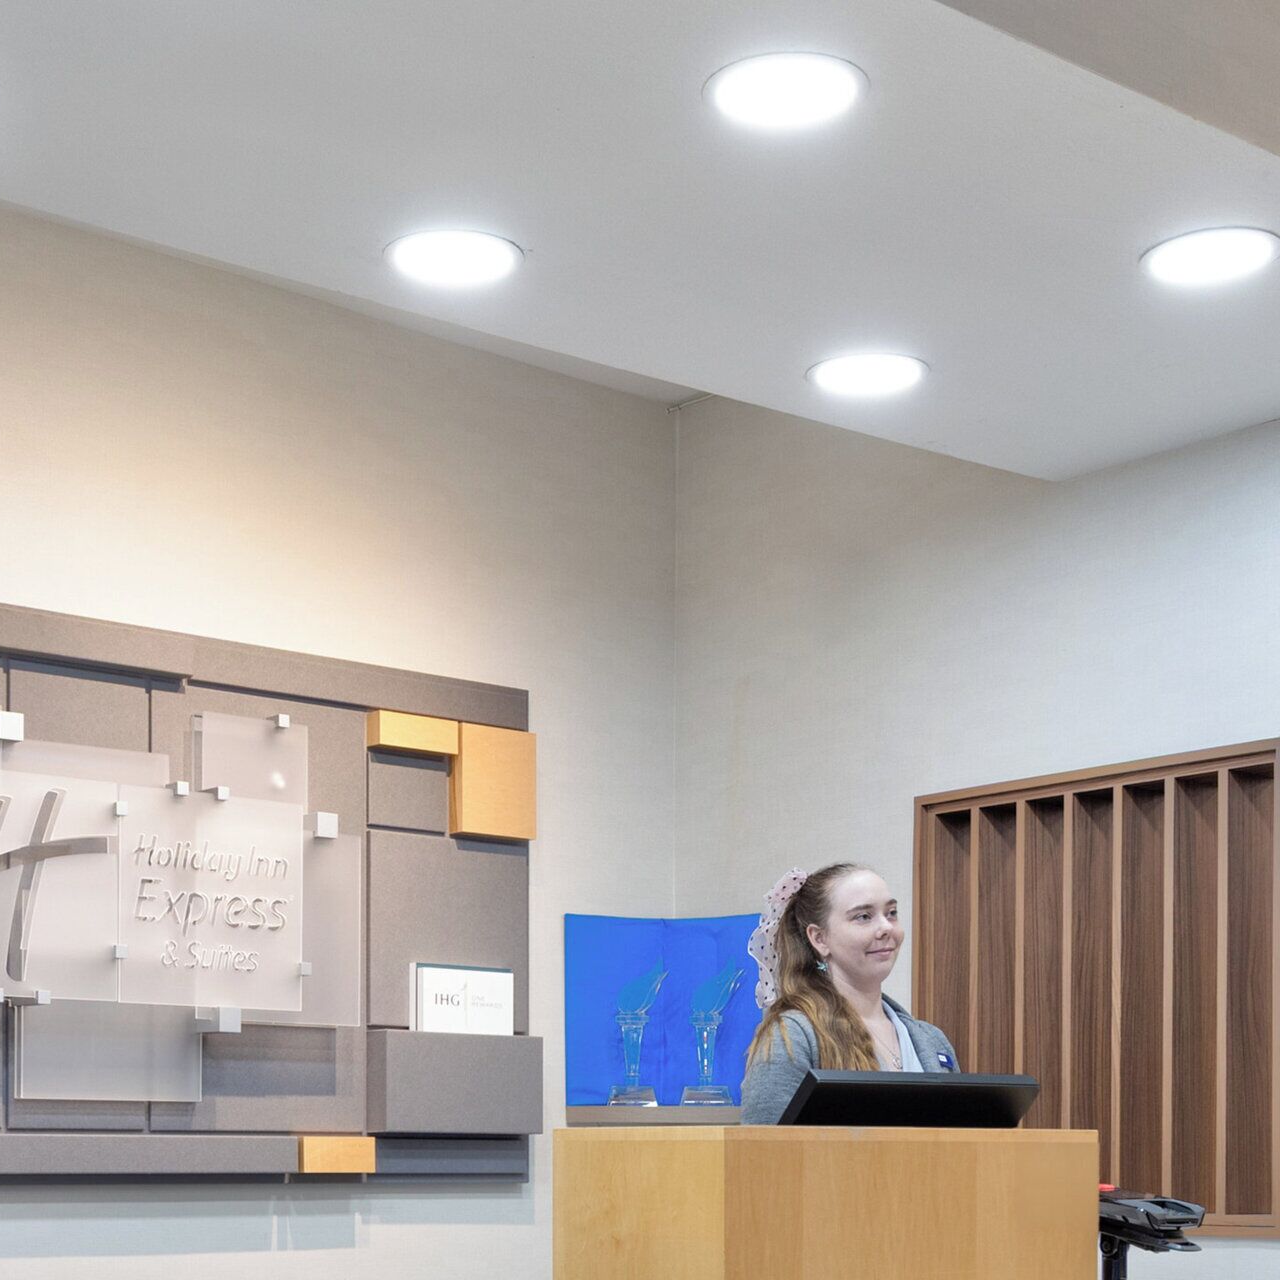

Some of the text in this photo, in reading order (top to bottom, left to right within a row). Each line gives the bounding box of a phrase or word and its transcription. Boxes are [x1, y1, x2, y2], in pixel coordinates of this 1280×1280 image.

[131, 833, 289, 882] Holiday Inn
[134, 876, 288, 936] Express
[160, 940, 260, 972] & Suites
[434, 993, 460, 1007] IHG
